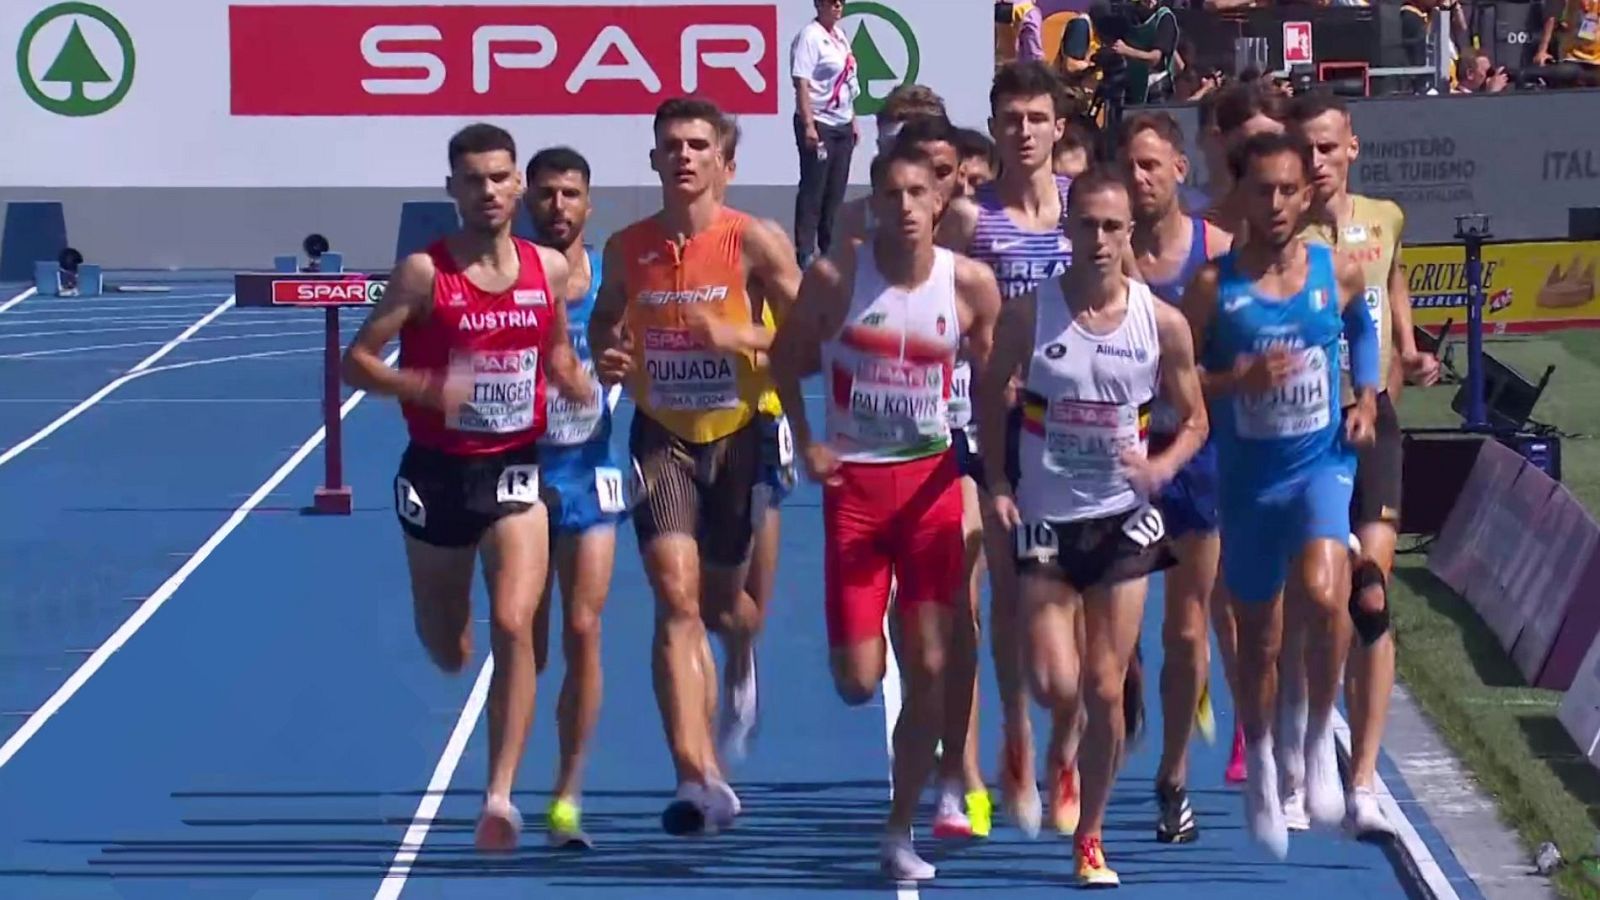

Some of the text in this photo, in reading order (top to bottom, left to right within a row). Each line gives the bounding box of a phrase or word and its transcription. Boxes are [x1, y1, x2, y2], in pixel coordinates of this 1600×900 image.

[360, 24, 767, 95] SPAR
[1361, 137, 1456, 159] MINISTERO
[1360, 160, 1475, 182] DEL TURISMO
[297, 284, 364, 300] SPAR
[637, 284, 728, 304] ESPAÑA
[458, 310, 538, 331] AUSTRIA
[1096, 344, 1133, 358] Allianz
[646, 357, 732, 382] QUIJADA
[473, 379, 532, 403] TTINGER
[506, 470, 531, 497] 13
[1024, 522, 1052, 546] 10
[1130, 510, 1160, 545] 10
